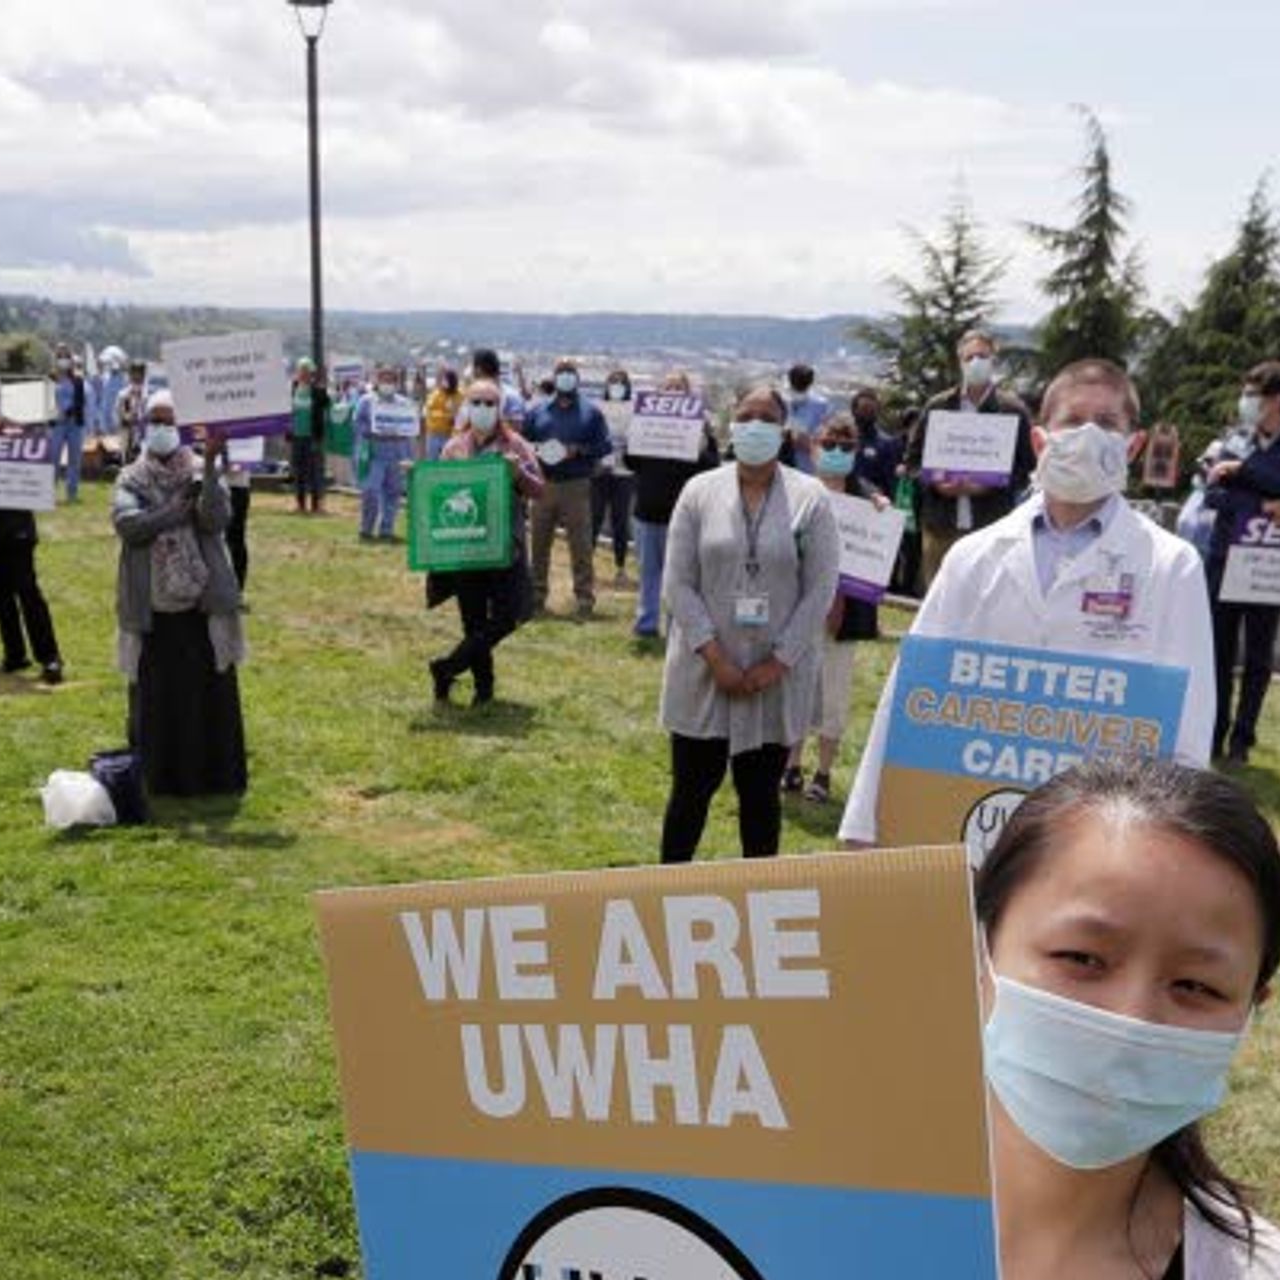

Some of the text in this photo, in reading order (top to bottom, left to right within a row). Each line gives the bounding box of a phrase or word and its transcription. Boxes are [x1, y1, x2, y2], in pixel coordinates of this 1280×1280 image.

[643, 396, 701, 416] SEIU
[950, 650, 1127, 705] BETTER
[905, 688, 1163, 752] CAREGIVER
[401, 890, 830, 1000] WE ARE
[460, 1023, 788, 1130] UWHA
